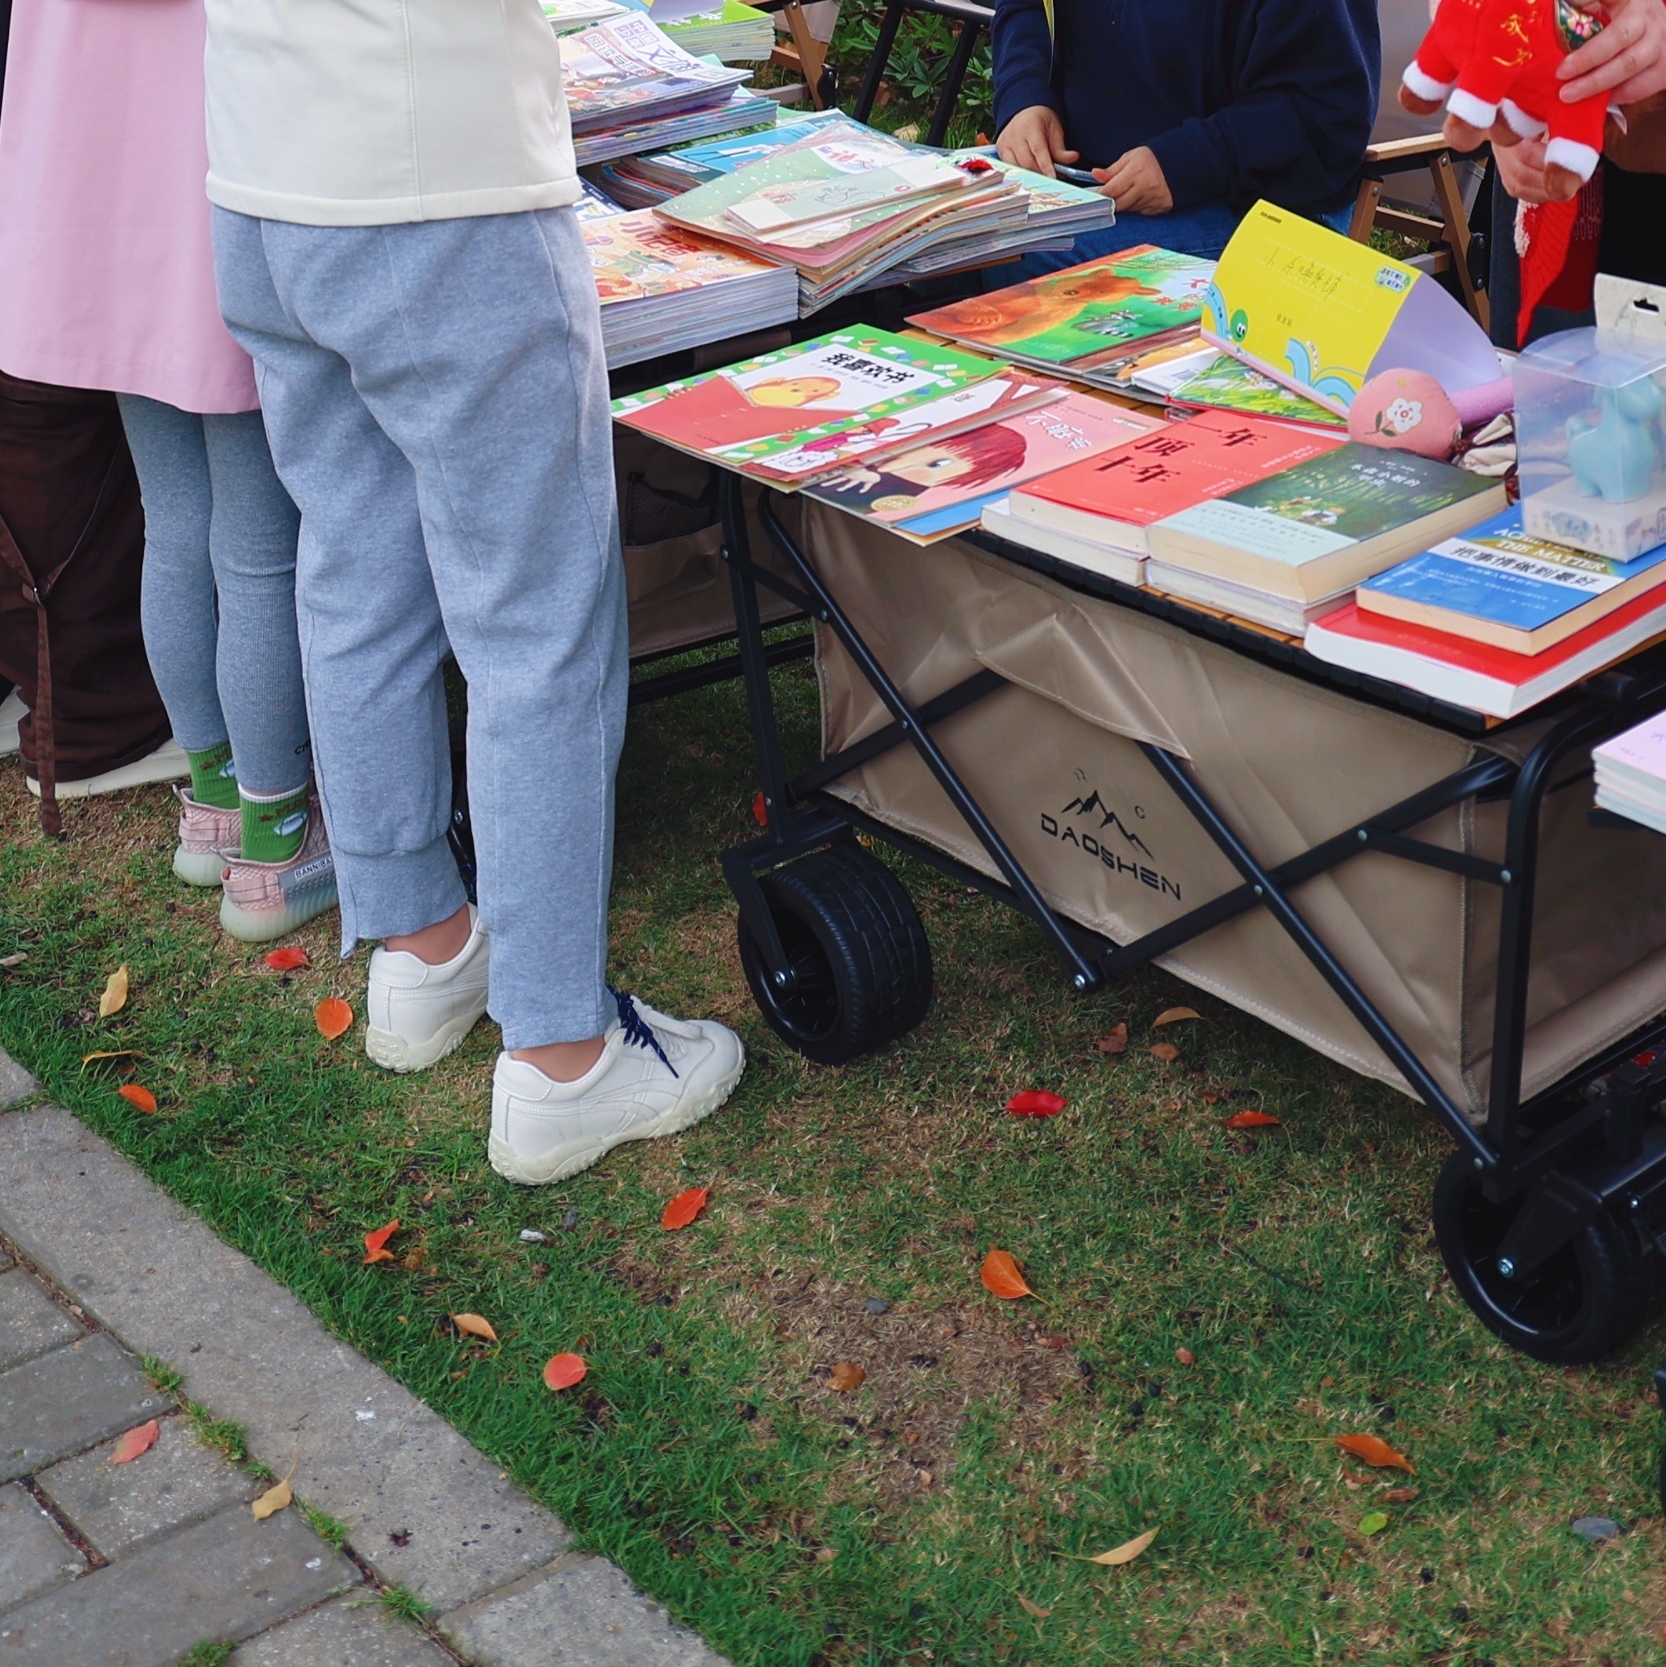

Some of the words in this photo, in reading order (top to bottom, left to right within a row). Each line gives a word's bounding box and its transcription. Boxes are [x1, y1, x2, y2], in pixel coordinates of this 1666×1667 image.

[619, 220, 702, 256] 小记者
[821, 352, 915, 384] 我喜欢书
[1133, 435, 1195, 458] 顶
[1186, 420, 1268, 448] 一年
[1094, 455, 1182, 485] 十年
[1450, 545, 1601, 588] 把事情做到最好
[1495, 539, 1533, 553] THE
[1534, 549, 1606, 571] MATTER
[1040, 811, 1183, 902] DAOSHEN
